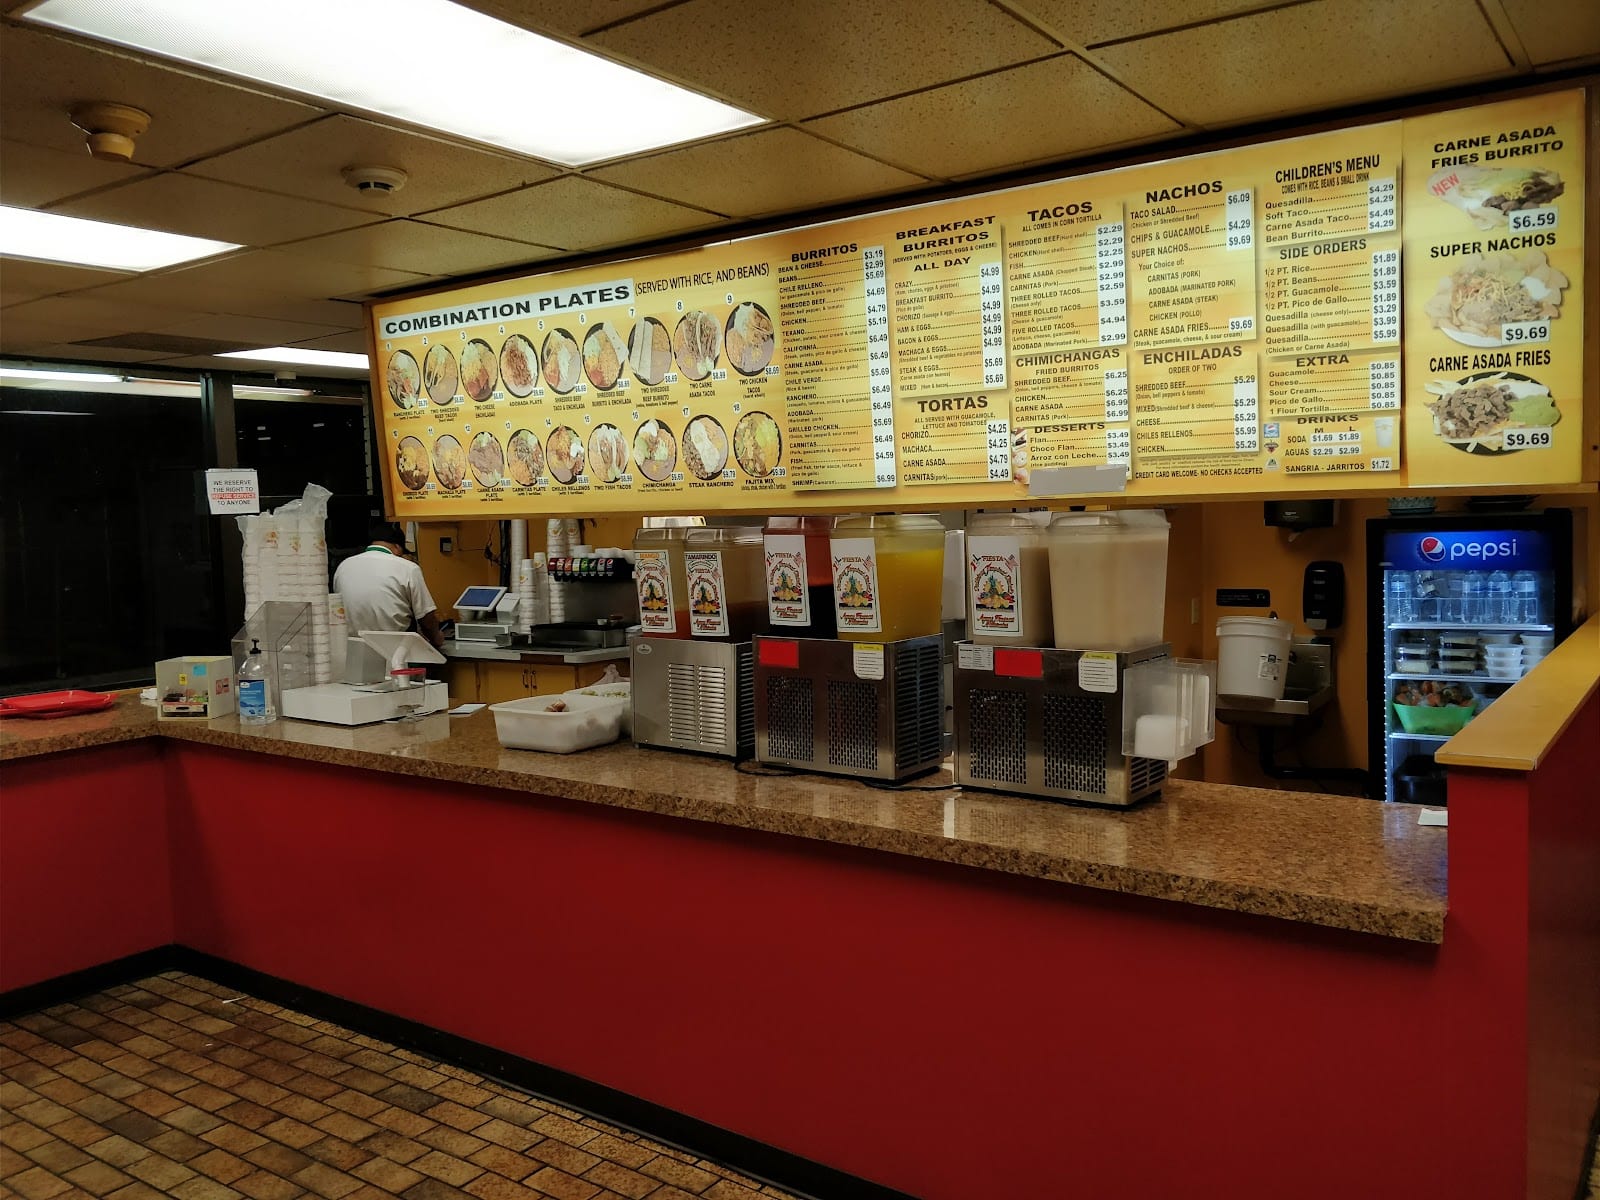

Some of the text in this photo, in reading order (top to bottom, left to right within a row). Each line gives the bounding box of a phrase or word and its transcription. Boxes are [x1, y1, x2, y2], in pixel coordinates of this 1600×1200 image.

[1433, 125, 1557, 154] CARNE ASADA
[1431, 139, 1564, 169] FRIES BURRITO
[1275, 154, 1381, 184] CHILDREN'S MENU
[1369, 183, 1394, 194] $4.29
[1431, 173, 1460, 197] NEW
[1146, 181, 1223, 204] NACHOS
[1228, 192, 1250, 205] $6.09
[1369, 194, 1394, 204] $4.29
[1027, 201, 1093, 222] TACOS
[1369, 208, 1394, 219] $4.49
[1033, 222, 1051, 231] COMES
[1052, 221, 1059, 229] IN
[1059, 218, 1075, 228] CORN
[1228, 219, 1251, 231] $4.29
[1369, 219, 1394, 230] $4.29
[1512, 211, 1556, 229] $6.59
[896, 215, 996, 241] BREAKFAST
[1097, 225, 1123, 235] $2.29
[903, 231, 989, 253] BURRITOS
[1098, 237, 1123, 247] $2.29
[1228, 234, 1251, 247] $9.69
[1430, 233, 1557, 258] SUPER NACHOS
[791, 244, 858, 263] BURRITOS
[864, 249, 883, 260] $3.19
[1098, 248, 1123, 258] $2.25
[1279, 239, 1367, 260] SIDE ORDERS
[1373, 252, 1396, 264] $1.89
[913, 257, 972, 272] ALL DAY
[1098, 260, 1124, 270] $2.99
[1138, 258, 1185, 271] Your Choice of:
[865, 271, 884, 280] $5.69
[980, 267, 1000, 277] $4.99
[1099, 271, 1124, 281] $2.99
[1147, 269, 1201, 283] CARNITAS (PORK)
[1373, 266, 1396, 277] $1.89
[1099, 282, 1124, 291] $2.59
[1148, 278, 1236, 296] ADOBADA (MARINATED PORK)
[1373, 280, 1396, 291] $3.59
[385, 264, 771, 335] COMBINATION PLATES (SERVED WITH RICE, AND BEANS)
[1100, 298, 1125, 308] $3.59
[1148, 294, 1219, 309] CARNE ASADA (STEAK)
[1373, 293, 1396, 304] $1.89
[867, 304, 886, 314] $4.79
[982, 300, 1001, 311] $4.99
[1373, 304, 1396, 315] $3.29
[1100, 315, 1125, 325] $4.94
[1149, 309, 1202, 322] CHICKEN (POLLO)
[868, 317, 887, 326] $5.19
[1230, 319, 1252, 331] $9.69
[1373, 316, 1396, 327] $3.99
[983, 326, 1002, 336] $4.99
[1373, 329, 1396, 340] $5.99
[1505, 326, 1548, 341] $9.69
[869, 333, 888, 343] $6.49
[1101, 333, 1126, 342] $2.99
[1016, 348, 1120, 368] CHIMICHANGAS
[1143, 346, 1243, 365] ENCHILADAS
[1296, 354, 1350, 368] EXTRA
[1429, 349, 1551, 373] CARNE ASADA FRIES
[984, 357, 1003, 368] $5.69
[1370, 362, 1395, 370] $0.85
[870, 368, 890, 377] $5.69
[1035, 363, 1100, 376] FRIED BURRITOS
[1168, 363, 1217, 374] ORDER OF TWO
[985, 374, 1004, 383] $5.69
[1105, 372, 1127, 380] $6.25
[1234, 375, 1255, 384] $5.29
[1370, 371, 1395, 381] $0.85
[1370, 381, 1395, 390] $0.85
[1105, 389, 1128, 397] $6.25
[1370, 391, 1395, 400] $0.85
[872, 401, 891, 410] $6.49
[917, 396, 989, 413] TORTAS
[1106, 399, 1128, 407] $6.99
[1234, 398, 1256, 408] $5.29
[1370, 401, 1395, 409] $0.85
[1106, 410, 1128, 418] $6.99
[1235, 412, 1256, 422] $5.29
[1297, 414, 1359, 425] DRINKS
[987, 424, 1007, 434] $4.25
[1034, 422, 1105, 434] DESSERTS
[1235, 427, 1256, 436] $5.99
[874, 434, 893, 443] $6.49
[988, 438, 1008, 449] $4.25
[1287, 433, 1360, 444] SODA $1.69 $1.89
[1507, 432, 1550, 446] $9.69
[1235, 440, 1257, 449] $5.29
[875, 451, 894, 460] $4.59
[1285, 447, 1309, 456] AGUAS
[1312, 447, 1334, 456] $2.29
[1338, 446, 1360, 454] $2.99
[989, 454, 1008, 464] $4.79
[1371, 460, 1390, 469] $1.72
[1135, 471, 1154, 479] CREDIT
[1209, 468, 1233, 476] CHECKS
[1233, 467, 1263, 475] ACCEPTED
[1285, 462, 1365, 473] SANGRIA JARRITOS
[876, 475, 895, 483] $6.99
[989, 469, 1009, 479] $4.49
[1450, 538, 1518, 561] pepsi
